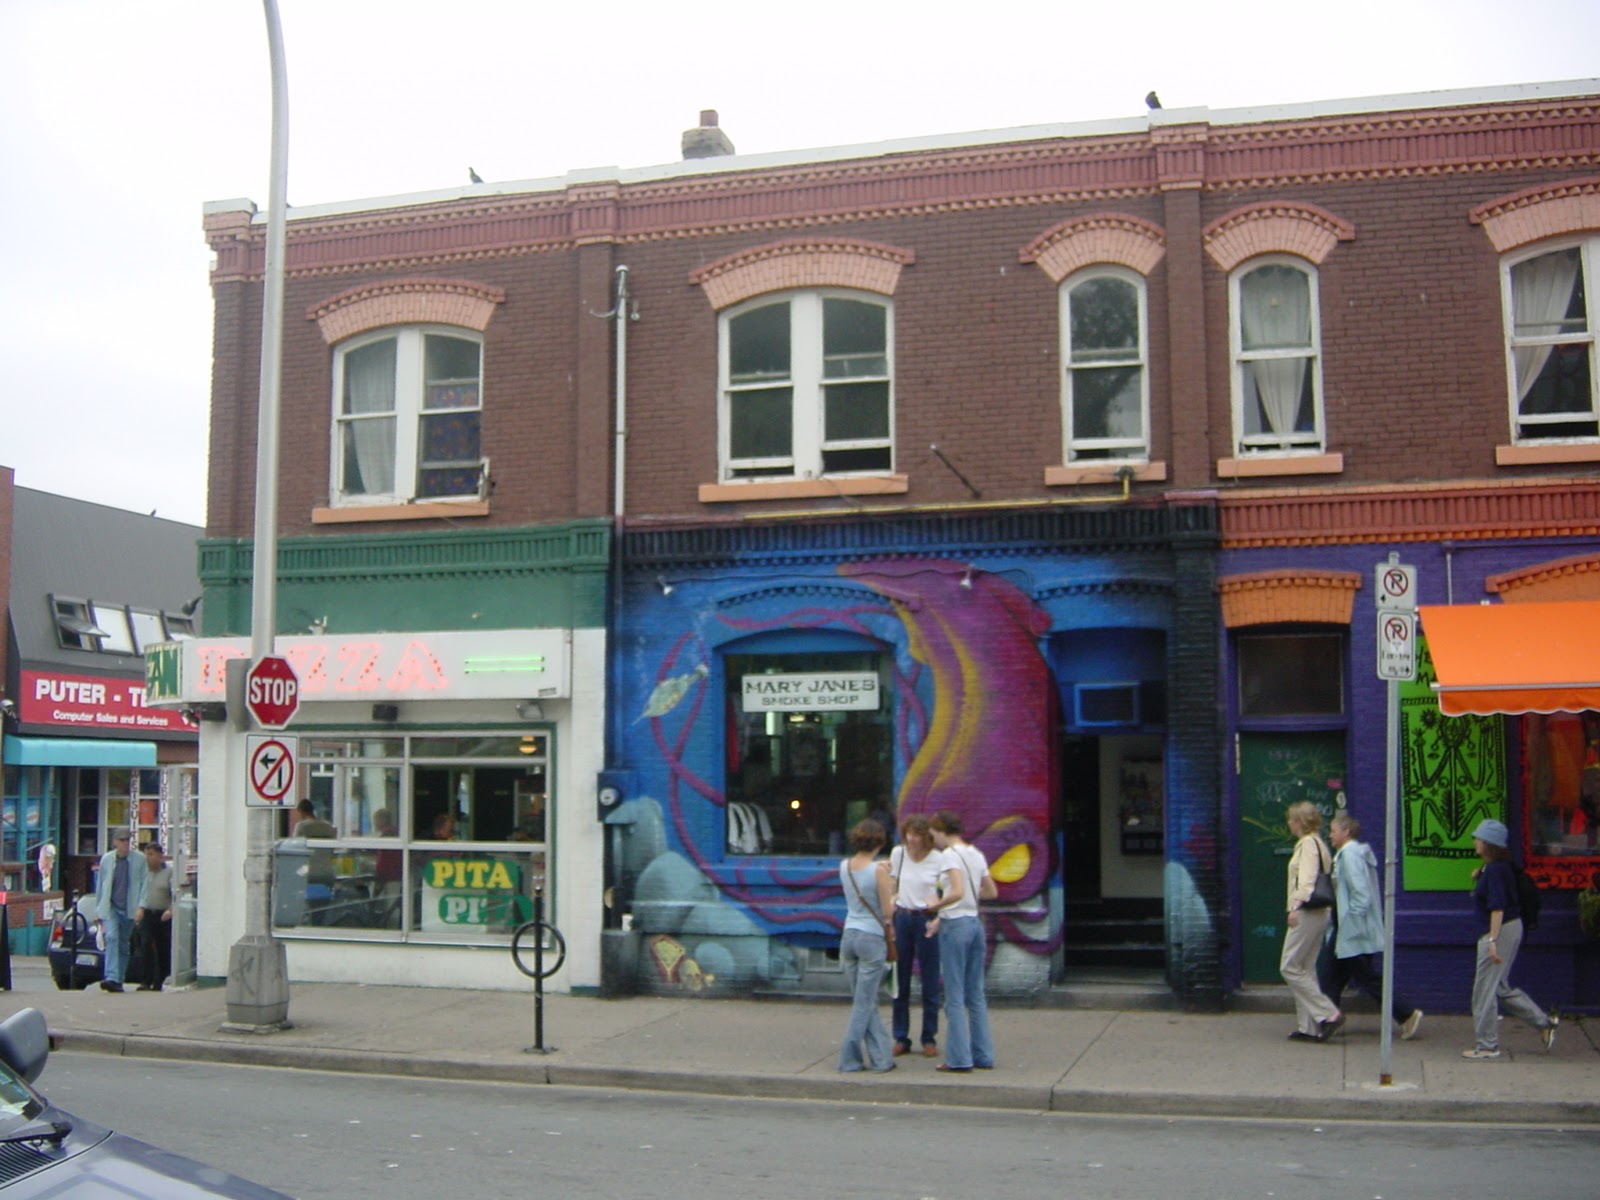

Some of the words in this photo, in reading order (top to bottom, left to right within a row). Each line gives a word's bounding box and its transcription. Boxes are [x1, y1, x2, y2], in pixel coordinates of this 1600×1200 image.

[196, 640, 448, 692] PZZA
[35, 679, 106, 705] PUTER
[250, 677, 297, 706] STOP
[745, 681, 803, 694] MARY
[808, 679, 876, 693] JANES
[761, 696, 812, 707] SMOKE
[817, 694, 860, 705] SHOP
[53, 710, 94, 722] Computer
[96, 712, 118, 724] Sales
[120, 715, 135, 725] and
[136, 715, 168, 727] Services
[432, 861, 513, 889] PITA
